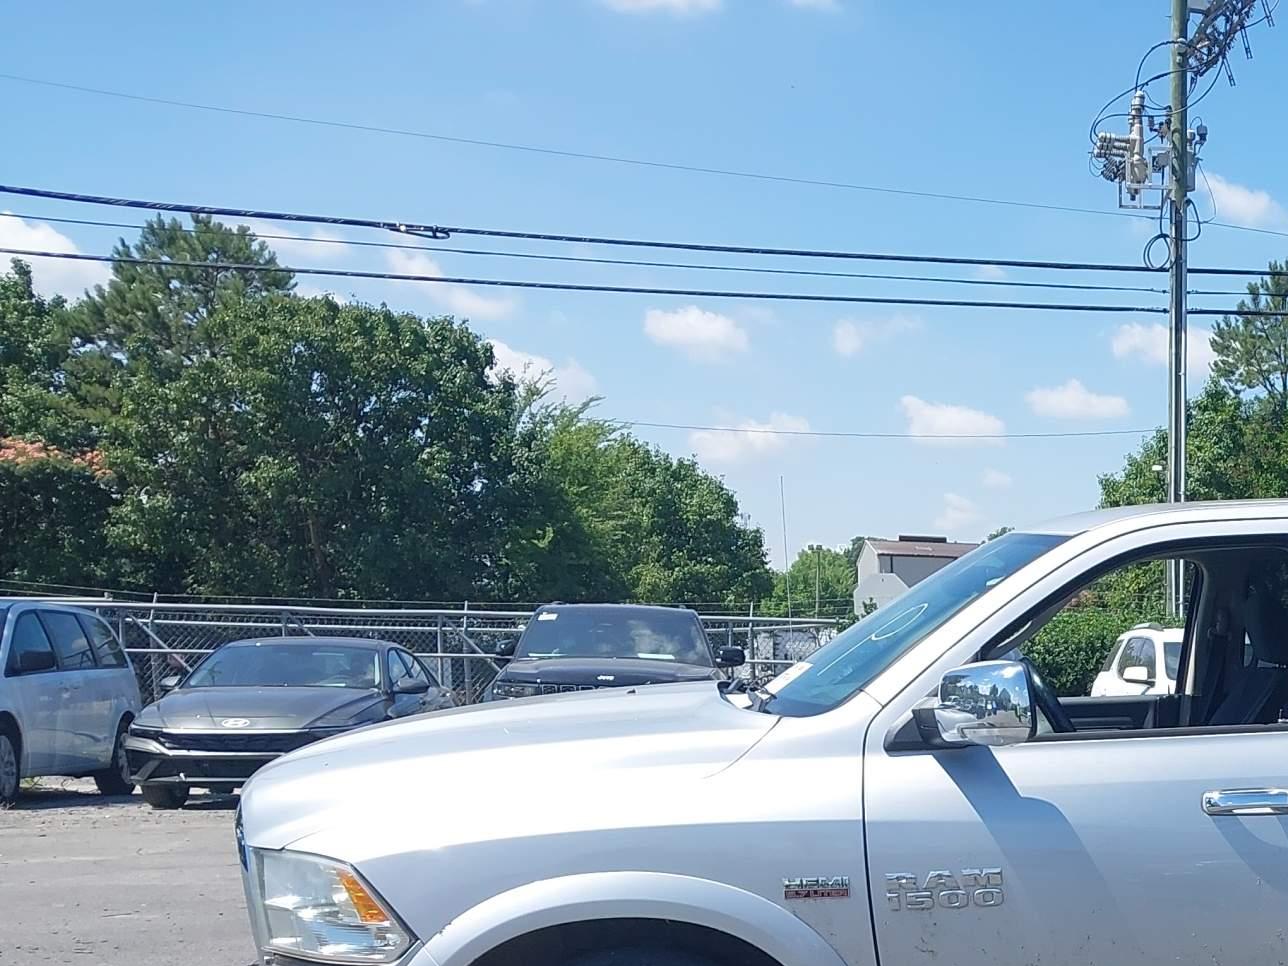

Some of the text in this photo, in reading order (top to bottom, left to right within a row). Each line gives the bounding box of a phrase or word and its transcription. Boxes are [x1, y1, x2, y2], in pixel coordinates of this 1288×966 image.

[783, 876, 849, 889] HEMI
[885, 867, 1003, 890] RAM
[886, 887, 1004, 911] 1500
